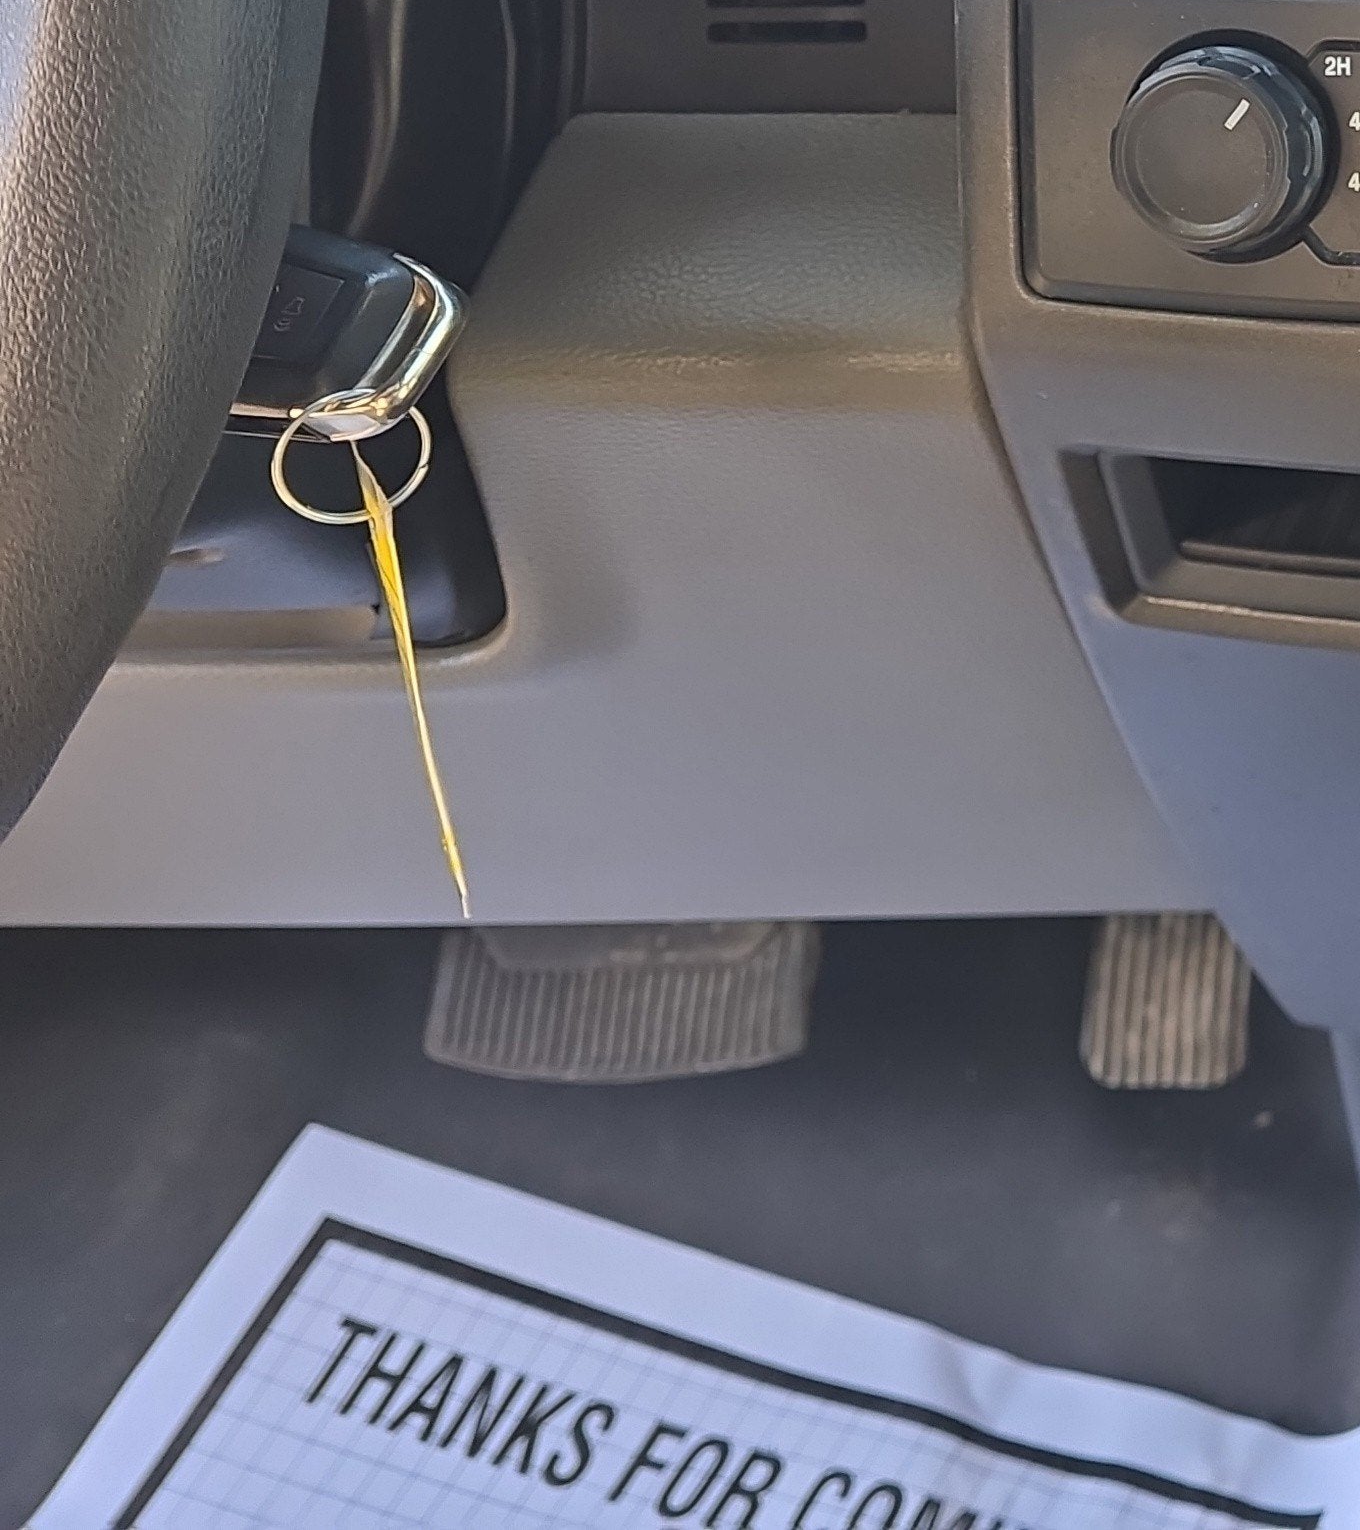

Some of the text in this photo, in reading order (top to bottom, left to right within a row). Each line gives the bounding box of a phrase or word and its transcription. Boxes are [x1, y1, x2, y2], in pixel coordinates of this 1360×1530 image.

[1324, 56, 1352, 76] 2H
[304, 1314, 617, 1487] THANKS
[607, 1418, 782, 1530] FOR
